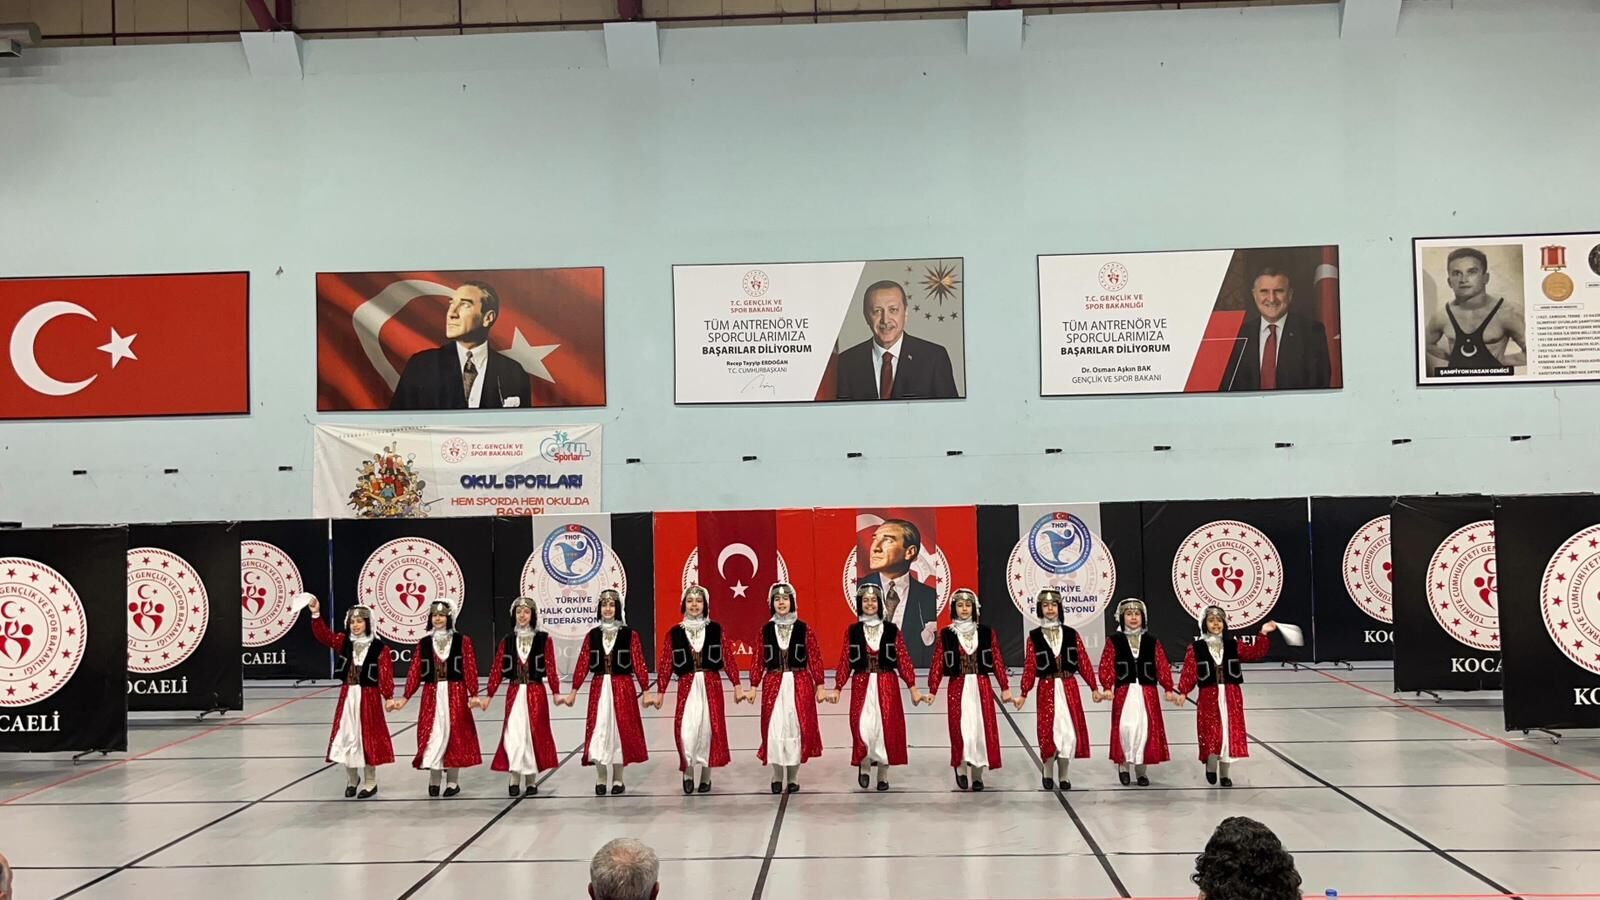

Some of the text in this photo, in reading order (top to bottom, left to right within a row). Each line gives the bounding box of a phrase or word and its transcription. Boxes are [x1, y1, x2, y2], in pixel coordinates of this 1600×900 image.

[704, 318, 808, 330] TÜM ANTRENÖR VE
[1062, 318, 1167, 331] TÜM ANTRENÖR VE
[708, 331, 806, 342] SPORCULARIMIZA
[1066, 331, 1164, 343] SPORCULARIMIZA
[702, 344, 812, 356] BAŞARILAR DİLİYORUM
[1061, 344, 1170, 356] BAŞARILAR DİLİYORUM
[1072, 376, 1102, 384] GENÇLİK
[460, 474, 582, 489] OKUL SPORLARI
[451, 497, 474, 505] HEM
[476, 497, 518, 505] SPORDA
[547, 497, 589, 505] OKULDA
[1216, 541, 1245, 551] GENÇLİK
[1246, 549, 1254, 558] VE
[1252, 557, 1262, 575] SPOR
[402, 558, 429, 567] GENÇLİK
[430, 565, 437, 574] VE
[269, 568, 276, 577] VE
[1452, 548, 1479, 597] CUMHURİYETİ
[136, 571, 168, 583] GENÇLİK
[168, 582, 176, 591] VE
[174, 591, 184, 610] SPOR
[37, 597, 48, 609] VE
[46, 609, 57, 632] SPOR
[24, 636, 57, 676] BAKANLIĞI
